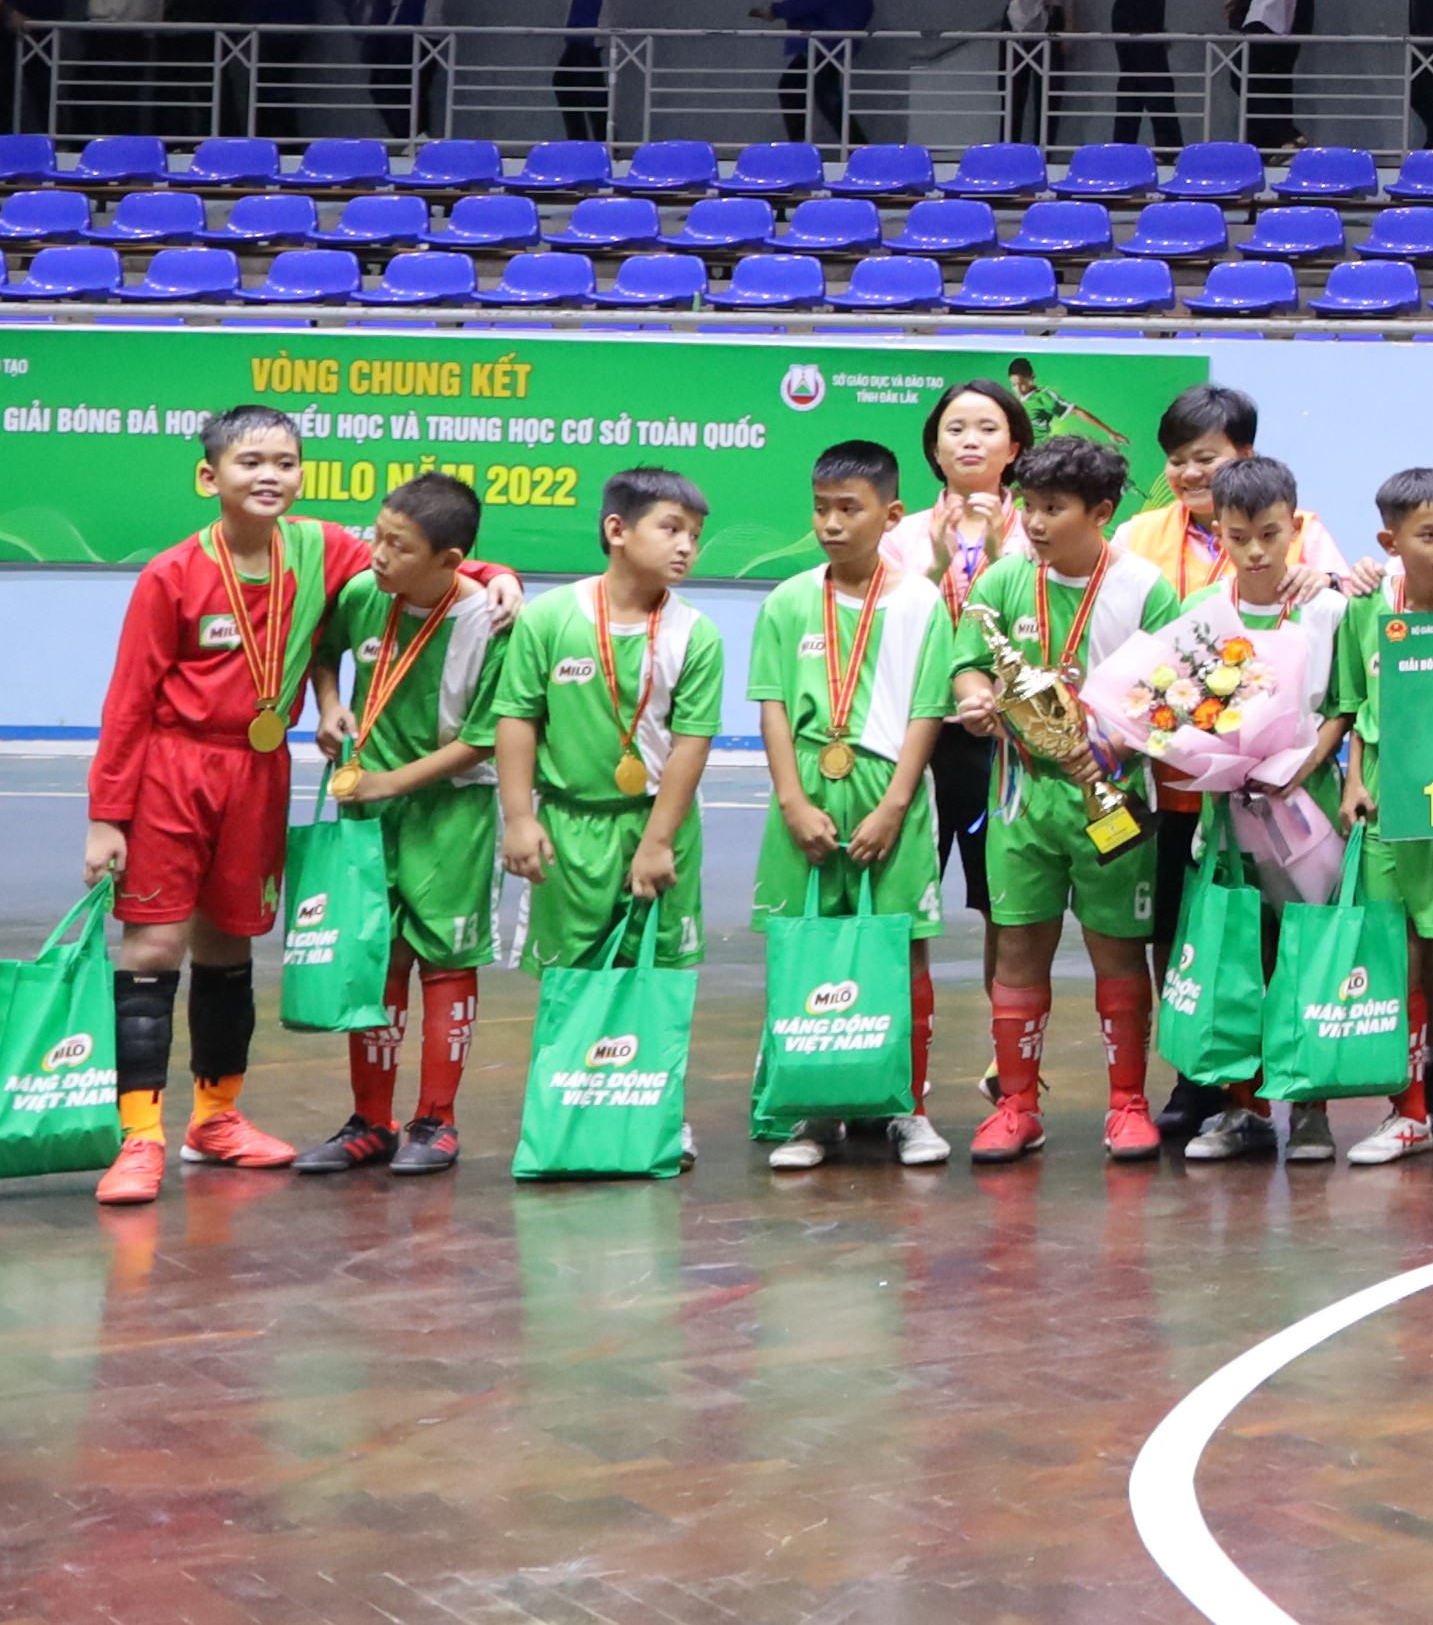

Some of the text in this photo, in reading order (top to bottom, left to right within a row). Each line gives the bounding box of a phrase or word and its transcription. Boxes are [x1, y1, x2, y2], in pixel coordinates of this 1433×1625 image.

[3, 358, 28, 376] TẠO
[252, 350, 532, 397] VÒNG CHUNG KẾT
[4, 400, 51, 432] GIẢI
[57, 404, 122, 433] BÓNG
[127, 405, 160, 434] ĐÁ
[337, 411, 766, 449] HỌC VÀ TRUNG HỌC CƠ SỞ TOÀN QUỐC
[485, 465, 577, 505] 2022
[558, 665, 592, 678] MILO
[1399, 658, 1418, 671] GIẢI
[919, 883, 940, 921] 4
[1135, 883, 1153, 918] 6
[815, 990, 851, 1005] MILO
[773, 1013, 891, 1034] NĂNG ĐỘNG
[785, 1032, 885, 1054] VIỆT NAM
